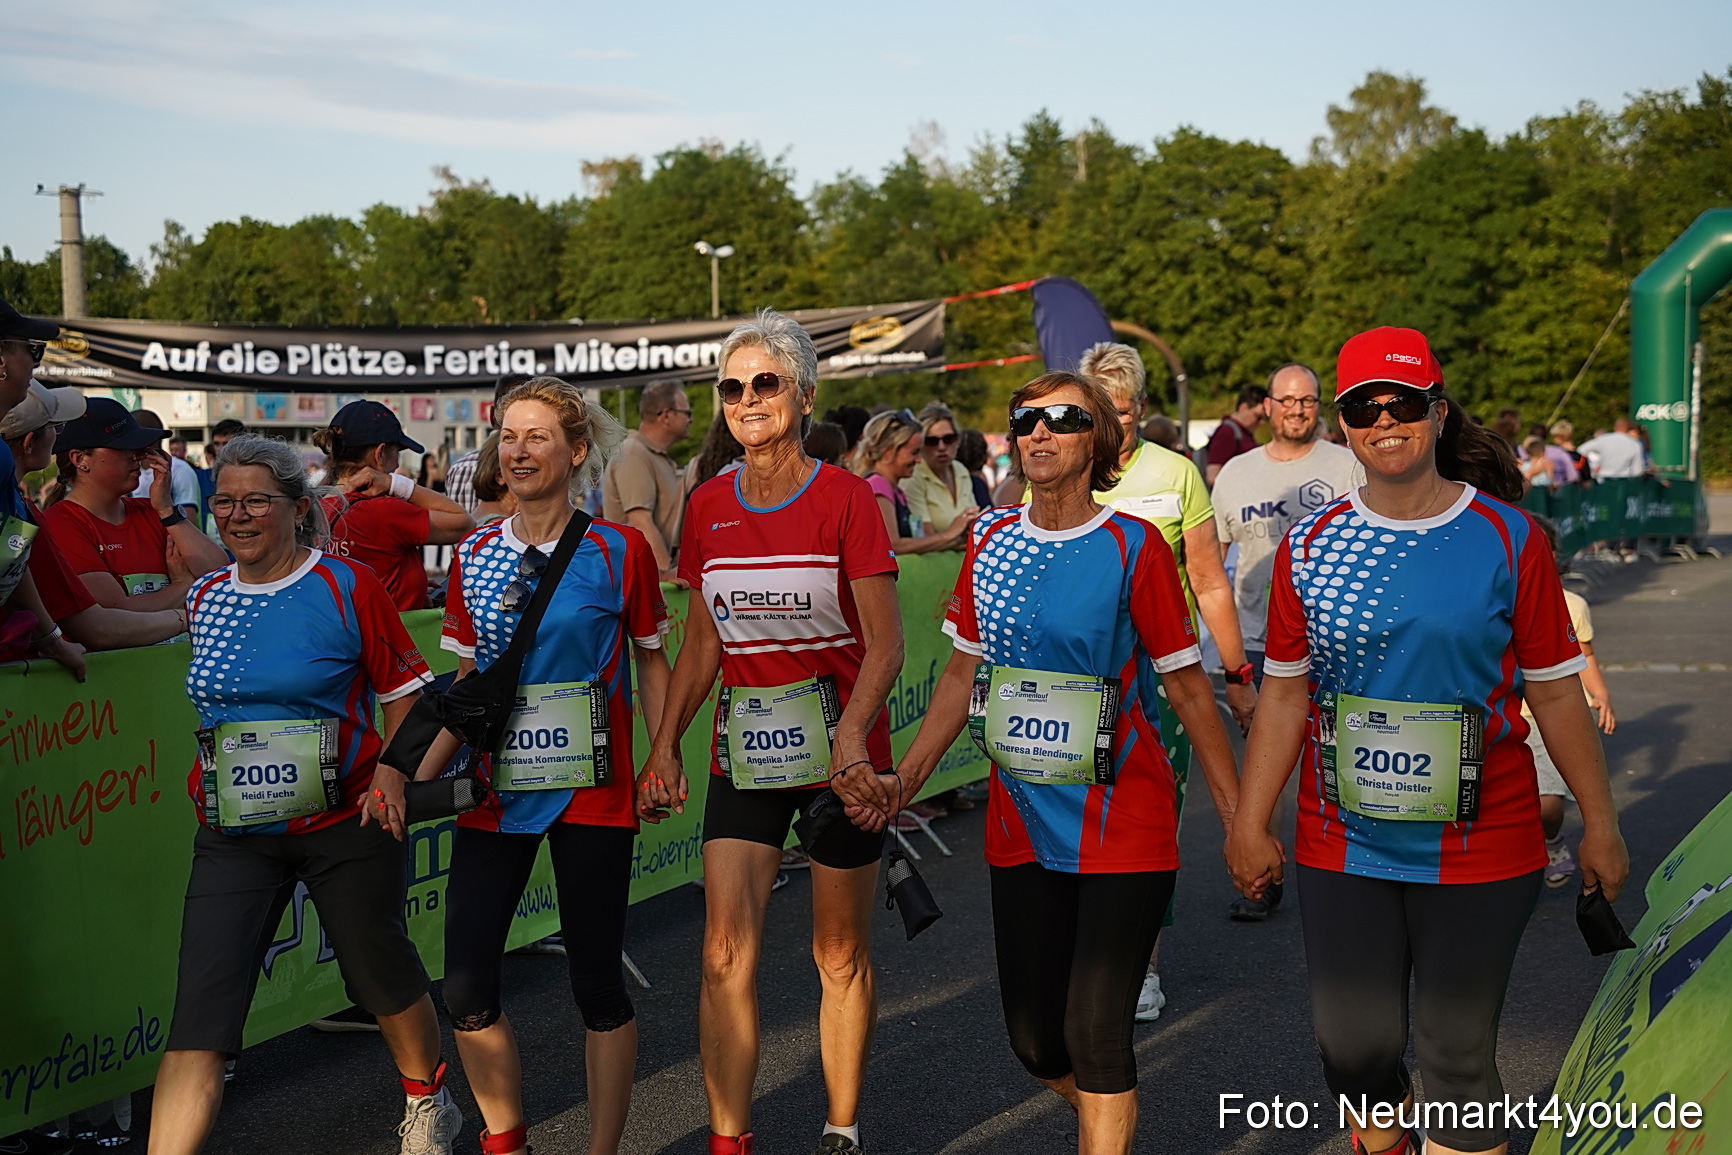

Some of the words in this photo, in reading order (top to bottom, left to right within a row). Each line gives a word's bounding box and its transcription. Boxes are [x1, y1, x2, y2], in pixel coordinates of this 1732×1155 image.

[141, 340, 212, 371] Auf
[217, 339, 281, 374] die
[287, 342, 416, 376] Plätze.
[555, 337, 723, 373] Miteinan
[1392, 353, 1422, 366] Petry
[1635, 403, 1672, 420] AOK
[1241, 500, 1289, 523] INK
[730, 590, 812, 611] Petry
[976, 672, 990, 680] AOK
[819, 682, 828, 706] RABATT
[1014, 692, 1048, 700] Firmenlauf
[512, 704, 540, 712] rmenlauf
[746, 706, 772, 714] Firmenlauf
[1322, 700, 1334, 708] AOK
[1007, 715, 1070, 744] 2001
[1363, 723, 1400, 731] Firmenlauf
[237, 740, 269, 749] Firmenlauf
[505, 728, 569, 750] 2006
[742, 726, 806, 750] 2005
[320, 755, 326, 763] 20
[498, 756, 534, 766] adyslava
[535, 752, 593, 764] Komarovska
[746, 756, 782, 766] Angelika
[784, 752, 811, 763] Janko
[994, 742, 1030, 755] Theresa
[1032, 746, 1084, 762] Blendinger
[1462, 749, 1467, 759] 20
[1098, 751, 1106, 779] HILTL
[1354, 746, 1432, 777] 2002
[231, 763, 298, 786] 2003
[1356, 776, 1392, 791] Christa
[1396, 782, 1432, 794] Distler
[15, 739, 161, 851] länger!
[242, 790, 264, 800] Heidi
[266, 790, 295, 799] Fuchs
[1462, 782, 1472, 814] HILTL
[0, 1006, 164, 1114] rpfalz.de
